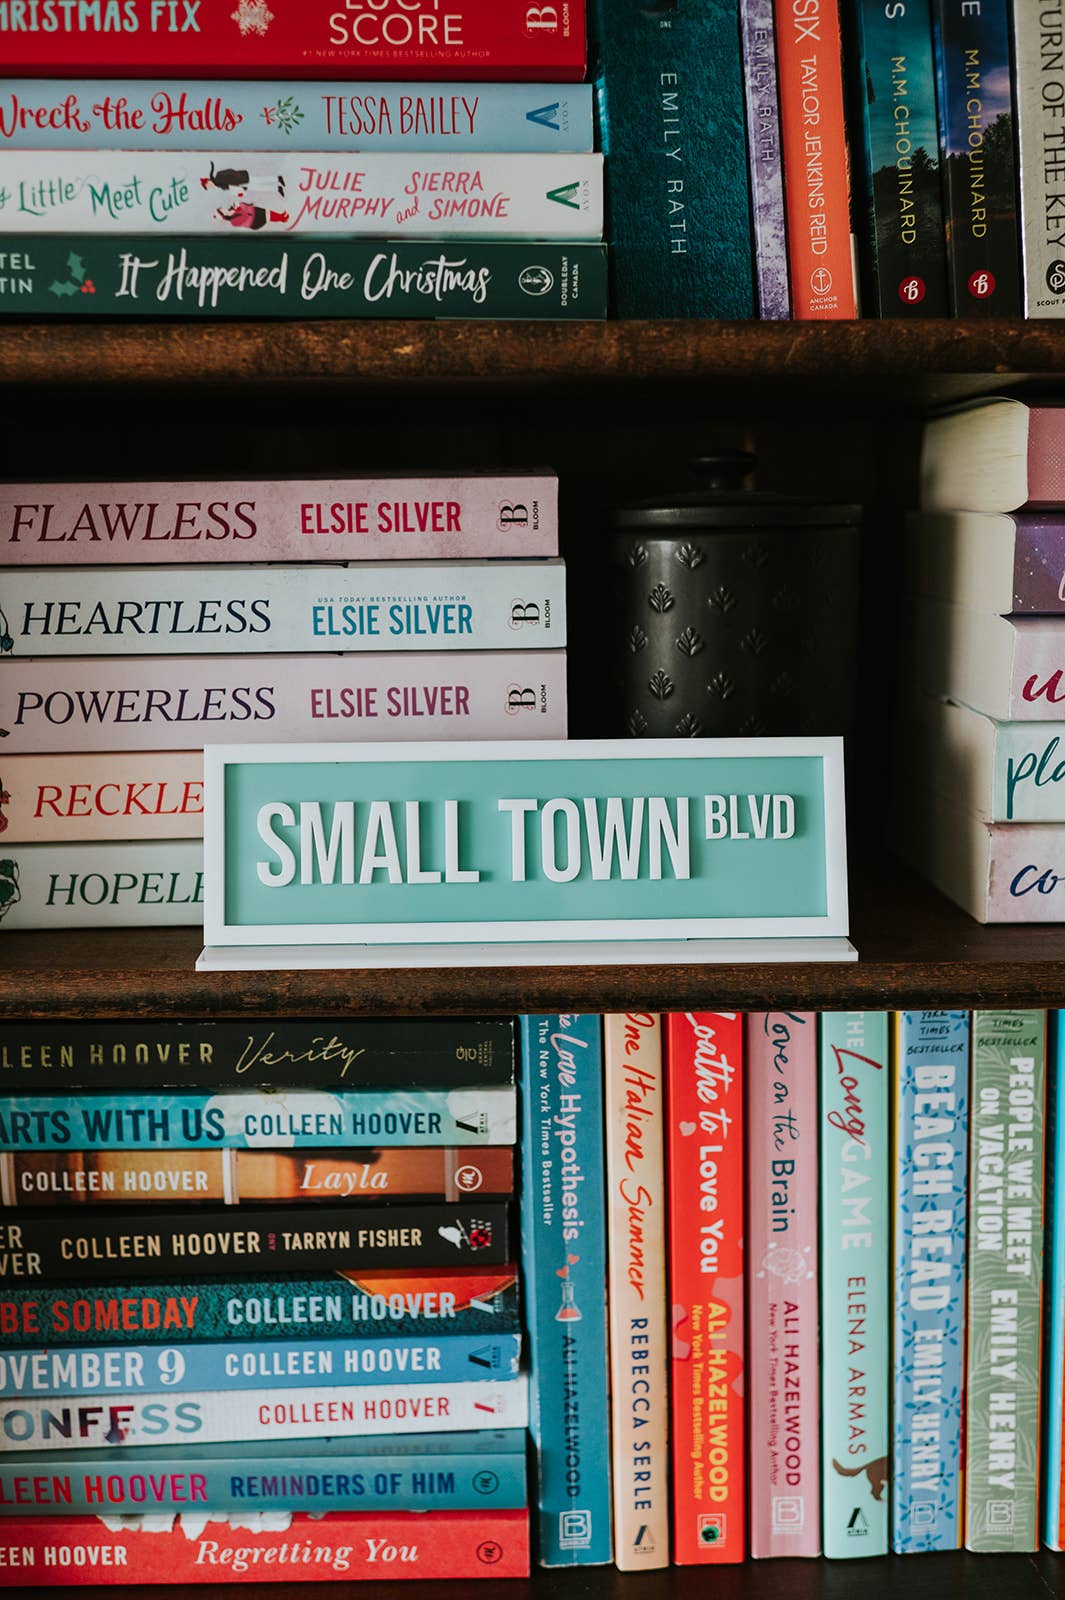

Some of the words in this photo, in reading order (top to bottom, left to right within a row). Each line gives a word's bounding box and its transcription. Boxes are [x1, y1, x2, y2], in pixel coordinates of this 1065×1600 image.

[151, 0, 201, 32] FIX
[329, 13, 464, 45] SCORE
[754, 29, 769, 97] EMILY
[800, 55, 821, 126] TAYLOR
[1041, 82, 1065, 118] OF
[93, 96, 146, 130] the
[151, 91, 243, 134] Halls
[321, 96, 393, 135] TESSA
[400, 96, 479, 135] BAILEY
[562, 101, 570, 132] AVON
[661, 72, 682, 162] EMILY
[758, 106, 774, 163] RATH
[805, 130, 825, 209] JENKINS
[966, 98, 988, 238] CHOUINARD
[1043, 125, 1065, 185] THE
[299, 167, 366, 193] JULIE
[404, 170, 484, 196] SIERRA
[893, 104, 917, 244] CHOUINARD
[17, 175, 75, 217] Little
[88, 175, 143, 220] Meet
[149, 176, 190, 222] Cute
[290, 195, 395, 226] MURPHY
[395, 196, 421, 225] and
[428, 191, 511, 221] SIMONE
[667, 179, 687, 255] RATH
[810, 213, 828, 256] REID
[1045, 193, 1065, 247] KEY
[115, 252, 159, 298] It
[156, 247, 288, 307] Happened
[300, 252, 355, 300] One
[363, 251, 491, 303] Christmas
[810, 296, 838, 304] ANCHOR
[810, 303, 838, 312] CANADA
[1037, 299, 1059, 307] SCOUT
[8, 501, 257, 542] FLAWLESS
[301, 502, 369, 534] ELSIE
[377, 501, 462, 533] SILVER
[20, 599, 272, 635] HEARTLESS
[312, 605, 380, 636] ELSIE
[389, 604, 473, 635] SILVER
[14, 687, 276, 725] POWERLESS
[311, 688, 378, 719] ELSIE
[386, 686, 470, 717] SILVER
[33, 781, 204, 817] RECKLE
[256, 800, 480, 889] SMALL
[498, 796, 691, 884] TOWN
[704, 794, 796, 840] BLVD
[539, 1020, 549, 1044] The
[921, 1027, 950, 1035] TIMES
[977, 1036, 1038, 1047] BESTSELLER
[992, 1018, 1024, 1028] TIMES
[90, 1043, 214, 1066] HOOVER
[235, 1031, 365, 1077] Verity
[539, 1050, 550, 1079] New
[550, 1033, 589, 1088] Love
[907, 1043, 964, 1055] BESTSELLER
[540, 1084, 551, 1112] York
[773, 1082, 788, 1104] on
[827, 1044, 883, 1146] Long
[979, 1088, 1000, 1115] ON
[1007, 1056, 1035, 1152] PEOPLE
[82, 1109, 169, 1143] WITH
[182, 1107, 226, 1142] US
[245, 1113, 342, 1136] COLLEEN
[353, 1112, 442, 1134] HOOVER
[622, 1063, 656, 1172] Italian
[700, 1108, 732, 1140] to
[772, 1109, 800, 1152] the
[912, 1064, 956, 1195] BEACH
[540, 1118, 551, 1155] Times
[21, 1170, 114, 1191] COLLEEN
[124, 1170, 208, 1191] HOOVER
[301, 1164, 389, 1197] Layla
[554, 1094, 585, 1241] Hypothesis
[699, 1145, 723, 1212] Love
[1007, 1159, 1034, 1199] WE
[541, 1161, 554, 1226] Bestseller
[772, 1159, 795, 1232] Brain
[839, 1138, 873, 1250] GAME
[976, 1124, 1005, 1251] VACATION
[61, 1235, 161, 1260] COLLEEN
[172, 1231, 261, 1256] HOOVER
[282, 1231, 350, 1250] TARRYN
[358, 1228, 422, 1248] FISHER
[620, 1179, 652, 1302] Summer
[699, 1219, 724, 1274] You
[1006, 1206, 1033, 1276] MEET
[909, 1209, 954, 1312] READ
[1, 1301, 39, 1333] BE
[53, 1296, 199, 1332] SOMEDAY
[227, 1296, 342, 1325] COLLEEN
[352, 1292, 456, 1321] HOOVER
[692, 1304, 702, 1330] New
[708, 1302, 727, 1339] ALI
[769, 1303, 778, 1326] New
[784, 1301, 799, 1334] ALI
[847, 1276, 866, 1355] ELENA
[562, 1335, 577, 1366] ALI
[692, 1334, 703, 1359] York
[768, 1330, 778, 1352] York
[989, 1289, 1018, 1381] EMILY
[158, 1349, 186, 1385] 9
[225, 1351, 333, 1377] COLLEEN
[344, 1347, 441, 1373] HOOVER
[631, 1318, 650, 1429] REBECCA
[769, 1358, 778, 1388] Times
[912, 1328, 943, 1405] EMILY
[259, 1401, 354, 1425] COLLEEN
[364, 1397, 450, 1420] HOOVER
[708, 1349, 728, 1503] HAZELWOOD
[784, 1344, 801, 1487] HAZELWOOD
[847, 1367, 866, 1456] ARMAS
[563, 1372, 580, 1498] HAZELWOOD
[910, 1412, 941, 1492] HENRY
[987, 1392, 1017, 1490] HENRY
[230, 1474, 365, 1497] REMINDERS
[375, 1473, 402, 1495] OF
[412, 1472, 455, 1494] HIM
[633, 1441, 651, 1511] SERLE
[693, 1461, 705, 1499] Author
[770, 1451, 779, 1485] Author
[84, 1473, 208, 1503] HOOVER
[44, 1545, 128, 1566] HOOVER
[195, 1540, 353, 1572] Regretting
[365, 1539, 418, 1563] You
